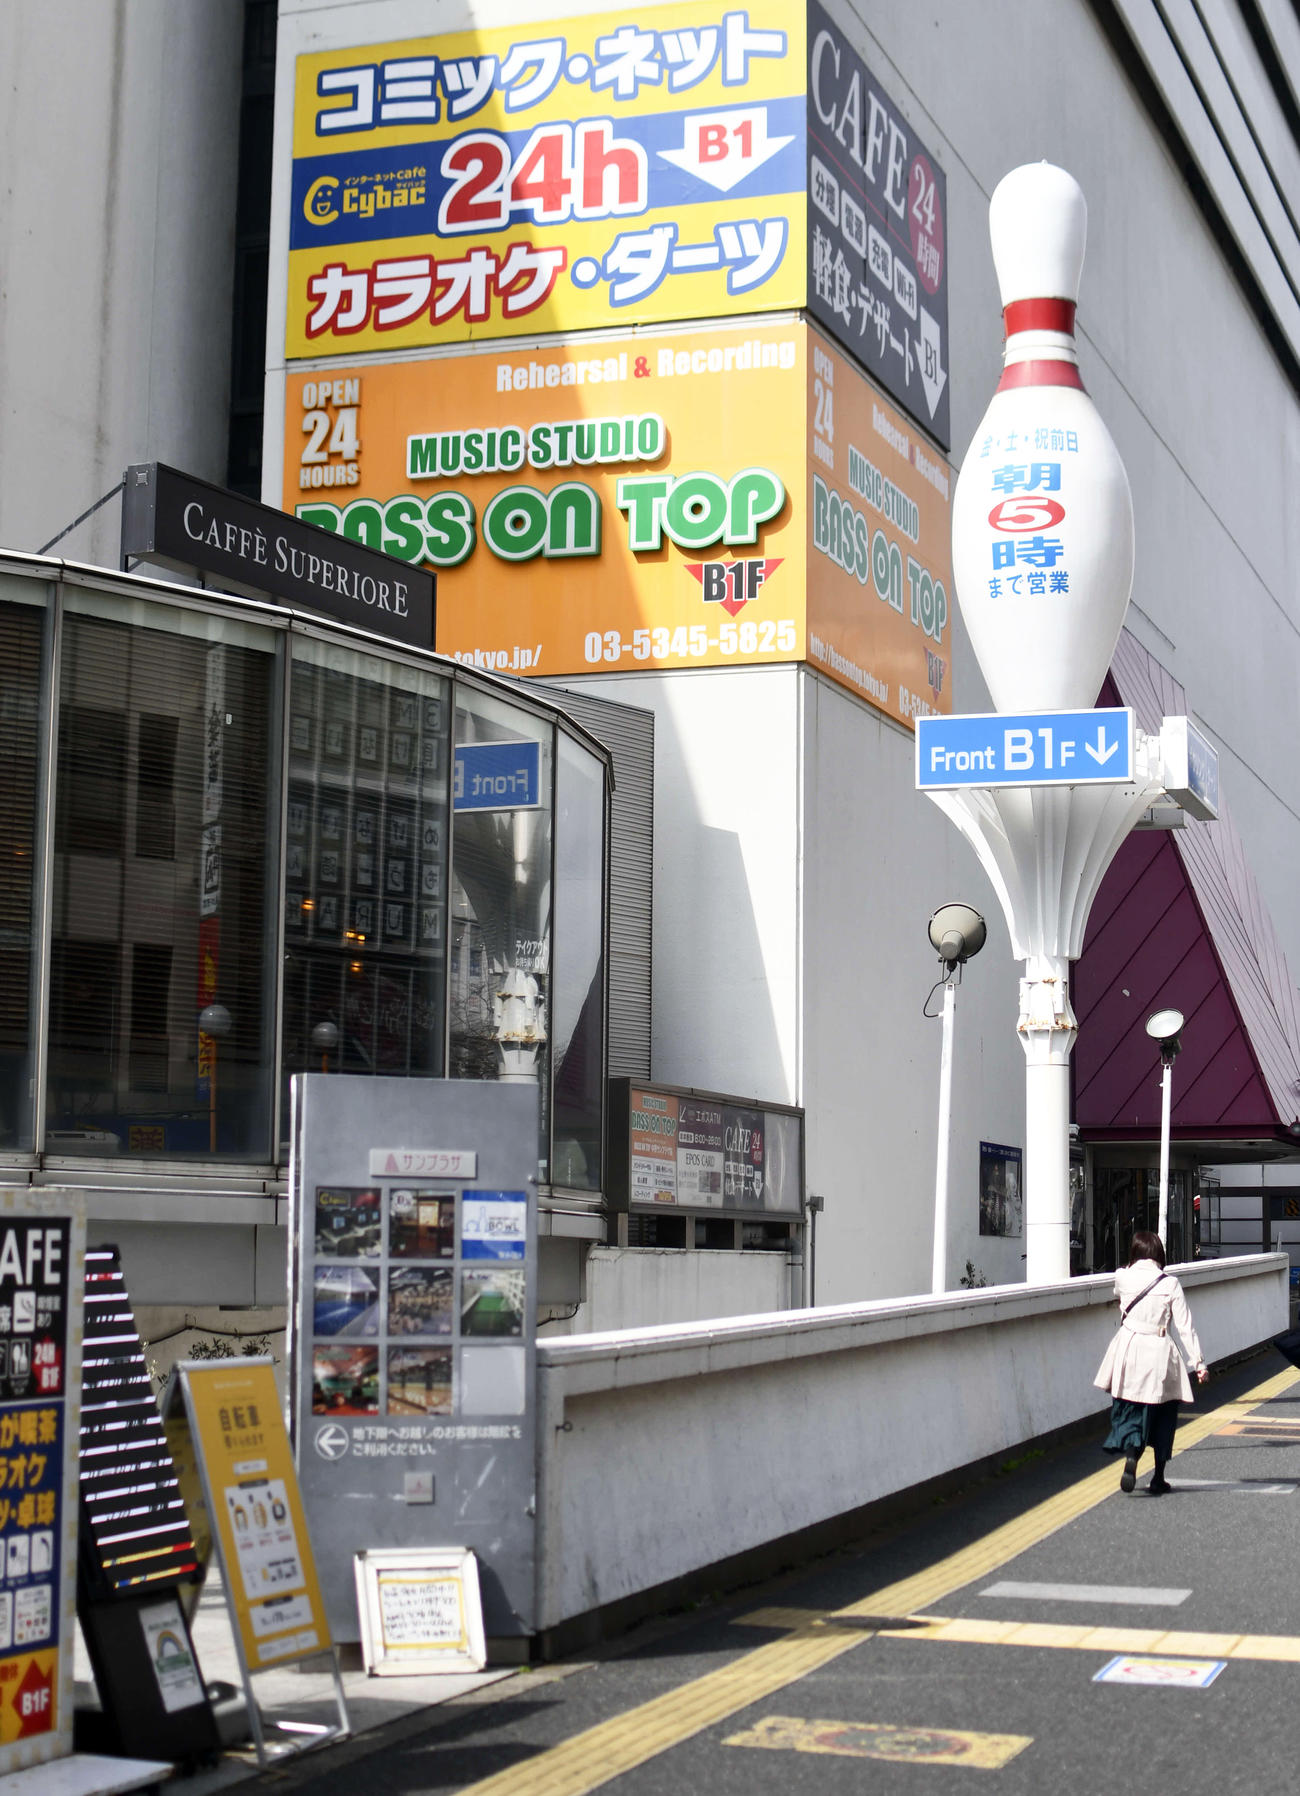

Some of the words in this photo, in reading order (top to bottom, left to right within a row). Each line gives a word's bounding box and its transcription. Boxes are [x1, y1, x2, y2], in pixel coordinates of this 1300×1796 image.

[317, 11, 787, 136] コミック・ネット
[699, 120, 752, 164] B1
[812, 30, 907, 219] CAFE
[440, 117, 647, 236] 24h
[343, 184, 426, 219] Cybac
[912, 164, 935, 235] 24
[306, 217, 787, 339] カラオケ・ダーツ
[916, 231, 940, 287] 時間
[812, 224, 914, 387] 軽食・デザート
[497, 353, 628, 392] Rehearsal
[633, 355, 651, 379] &
[657, 341, 796, 377] Recording
[923, 337, 938, 386] B1
[302, 378, 361, 410] OPEN
[813, 378, 834, 444] 24
[301, 408, 360, 464] 24
[407, 427, 524, 478] MUSIC
[527, 413, 666, 469] STUDIO
[299, 463, 360, 490] HOURS
[848, 443, 883, 513] MUSIC
[883, 476, 919, 545] STUDIO
[991, 462, 1062, 494] 朝
[482, 482, 602, 561] ON
[616, 467, 784, 551] TOP
[994, 498, 1055, 533] 5
[183, 501, 267, 566] CAFFÈ
[275, 535, 409, 618] SUPERIORE
[813, 471, 869, 582] BASS
[872, 528, 904, 615] ON
[907, 553, 948, 645] TOP
[991, 536, 1065, 570] 時
[703, 559, 765, 603] B1F
[988, 571, 1070, 599] まで営業
[584, 619, 797, 663] 03-5345-5825
[927, 649, 943, 692] B1F
[930, 745, 996, 772] Front
[685, 1153, 700, 1166] EPOS
[725, 1126, 751, 1154] CAFE
[752, 1132, 761, 1149] 24
[402, 1153, 462, 1172] サンプラザ
[22, 1687, 49, 1716] B1F
